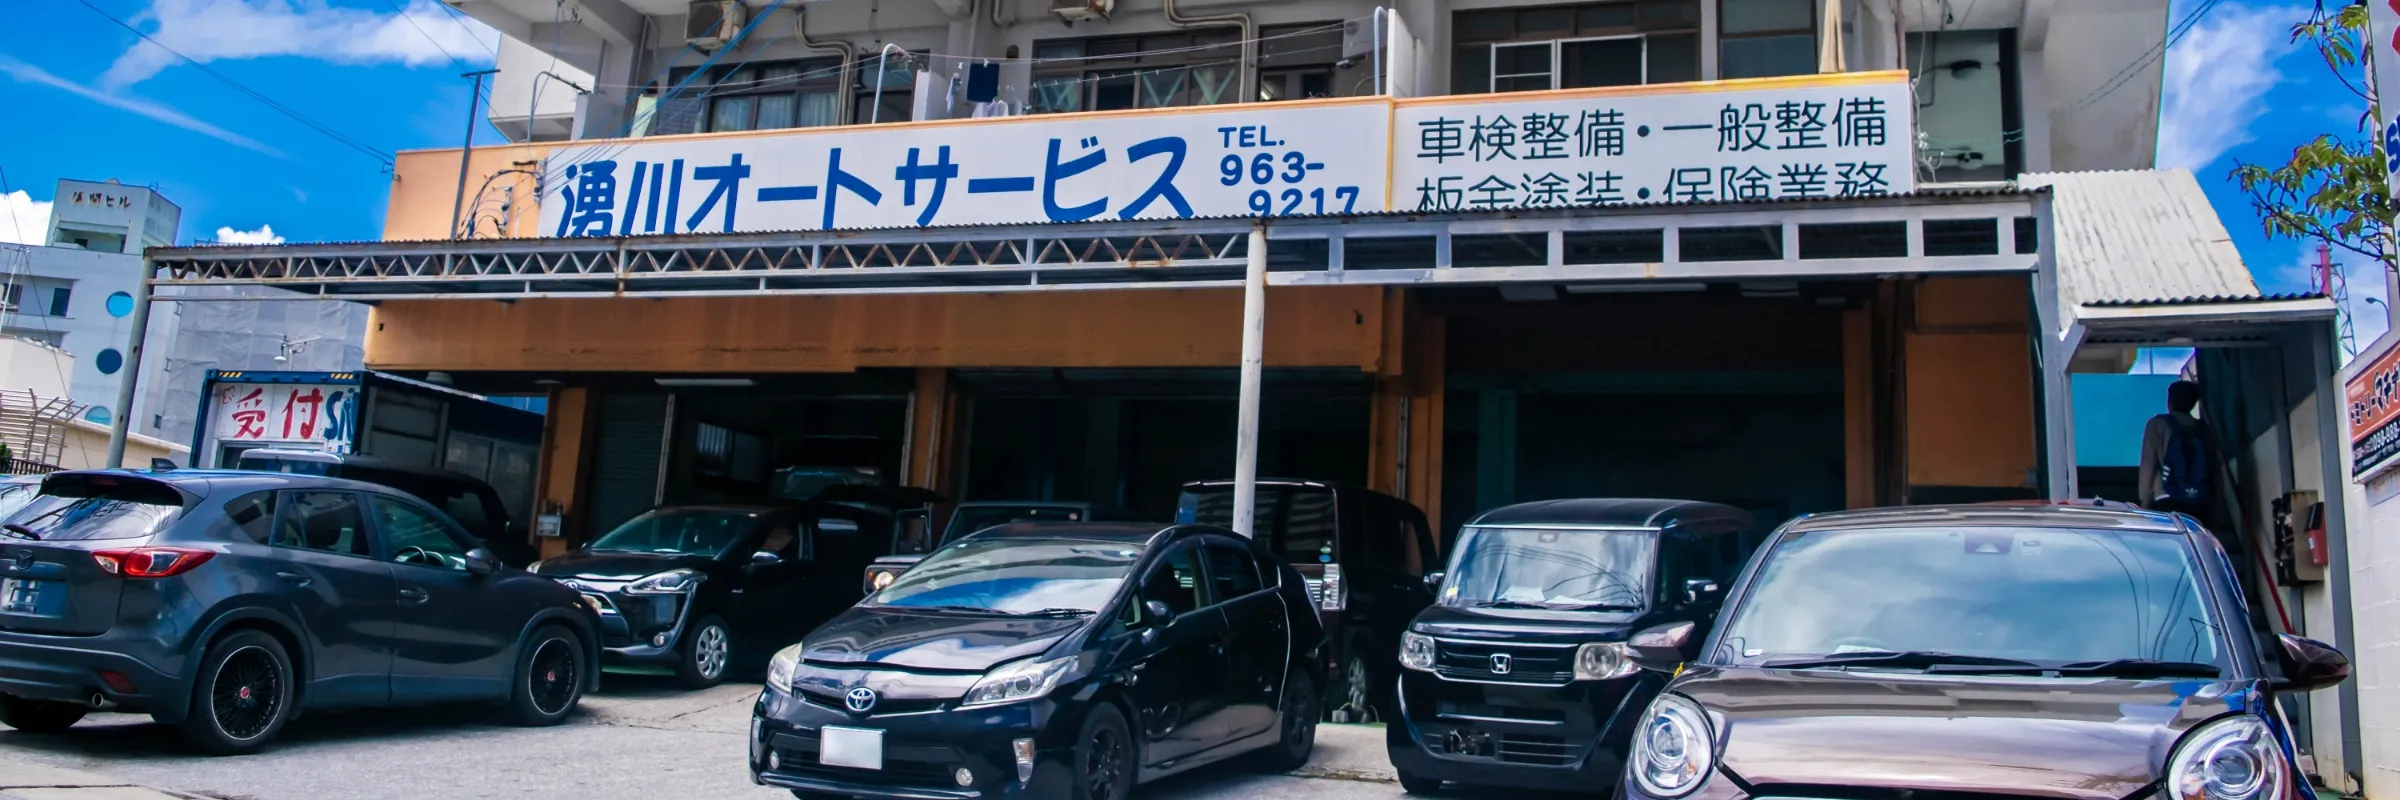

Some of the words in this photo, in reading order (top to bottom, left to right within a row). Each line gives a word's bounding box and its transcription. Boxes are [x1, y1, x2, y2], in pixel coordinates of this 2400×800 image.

[1217, 125, 1285, 149] TEL.
[1416, 96, 1887, 164] 車検整備・一般整備
[555, 135, 1194, 238] 湧川オートサービス
[1220, 151, 1325, 187] 963-
[1248, 186, 1360, 217] 9217
[232, 387, 323, 440] 受付
